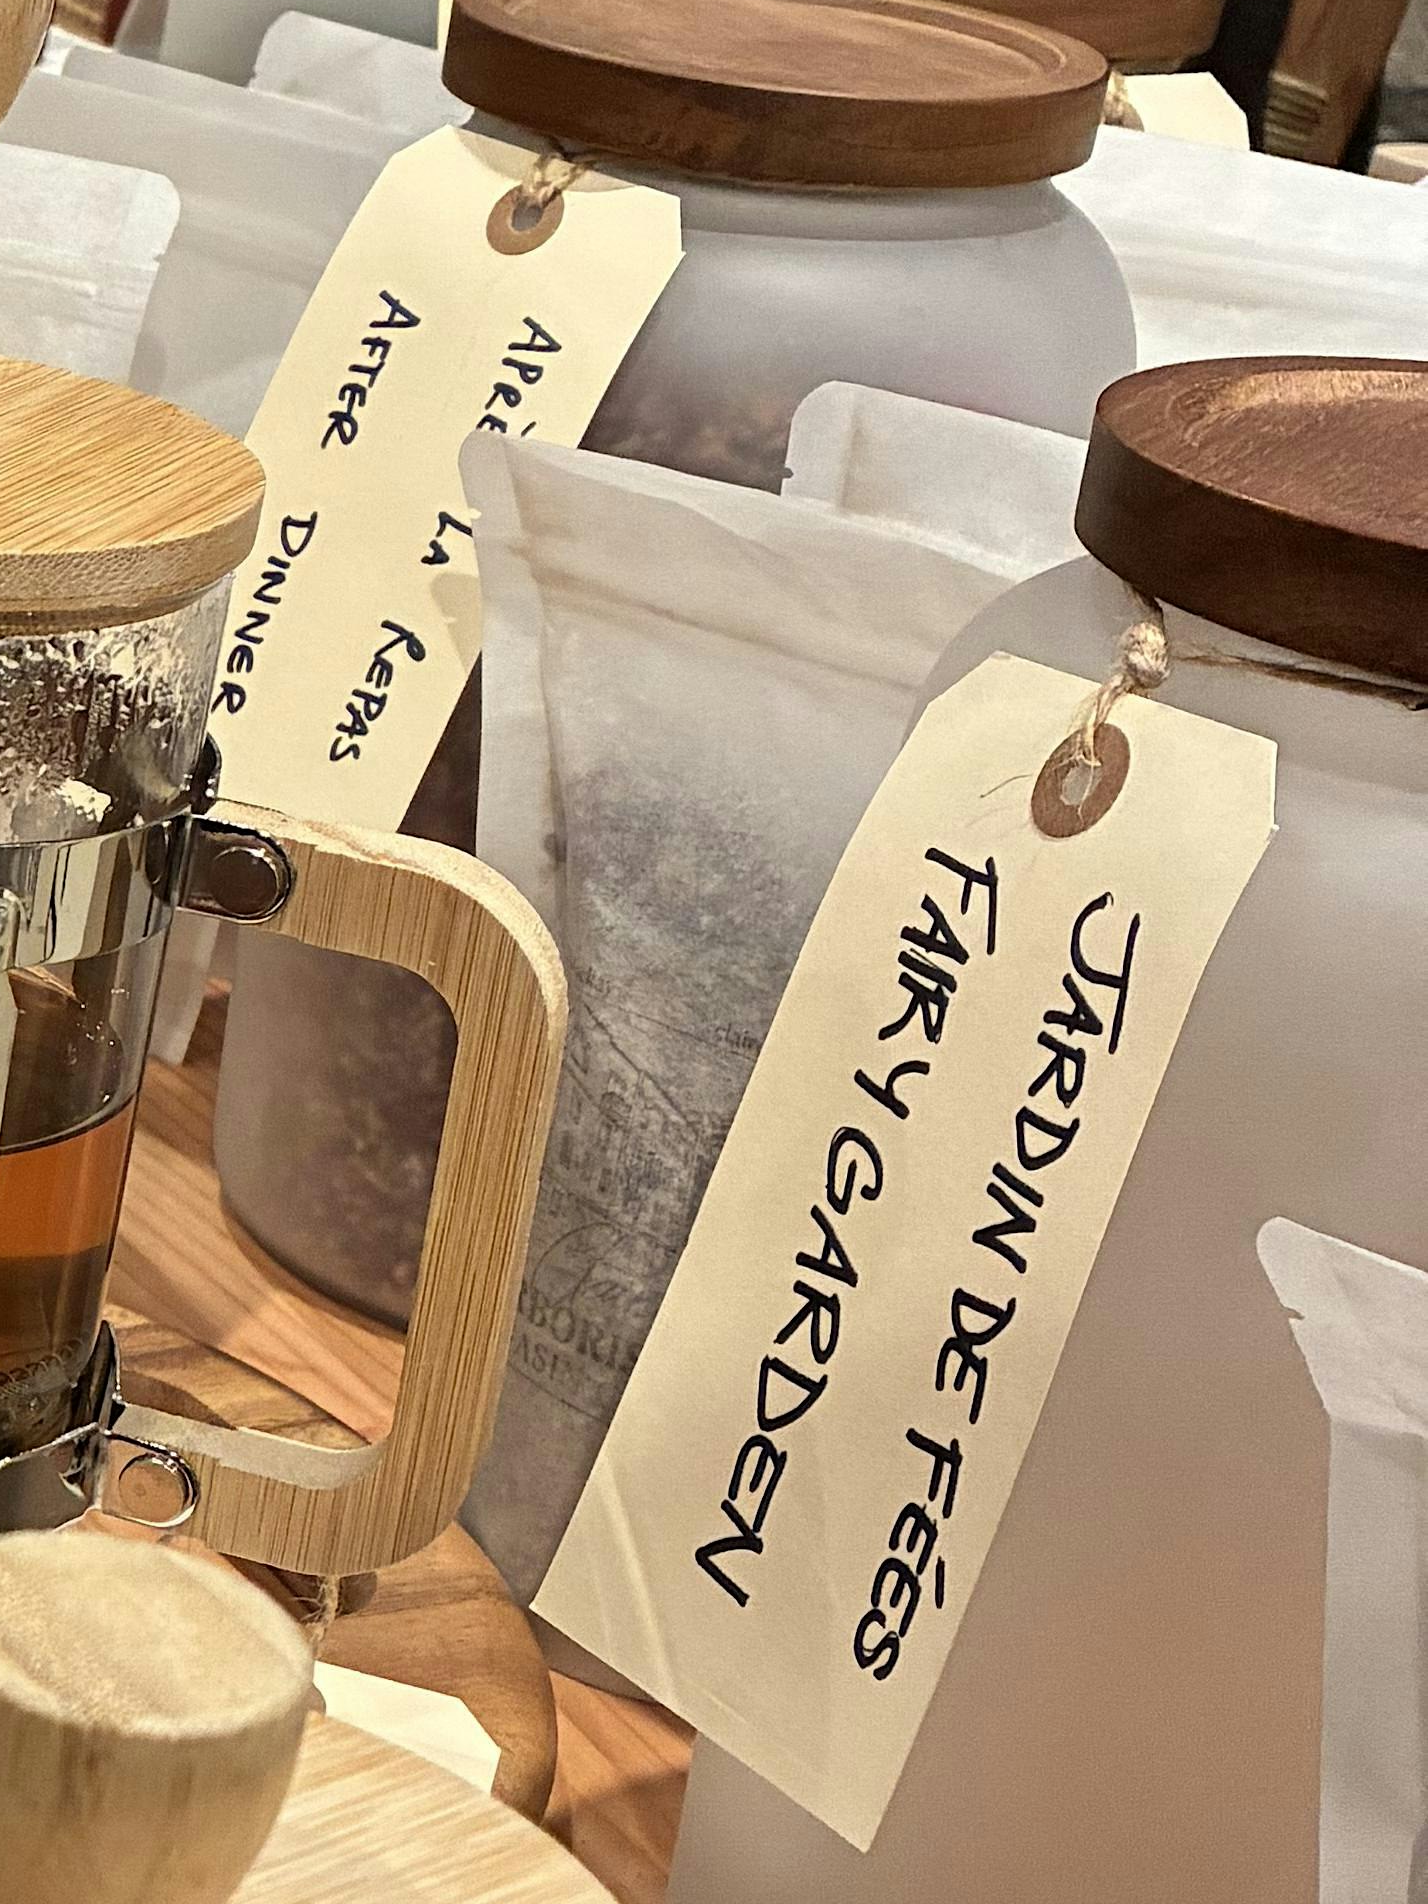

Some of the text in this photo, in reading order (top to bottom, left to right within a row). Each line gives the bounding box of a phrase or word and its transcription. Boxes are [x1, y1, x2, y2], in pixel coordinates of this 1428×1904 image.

[209, 290, 421, 717] AFTER DINNER
[328, 316, 563, 766] APRÈ LA REPAS
[693, 847, 1000, 1611] FAIRY GARDEN
[850, 890, 1142, 1682] JARDIN DE FÉES
